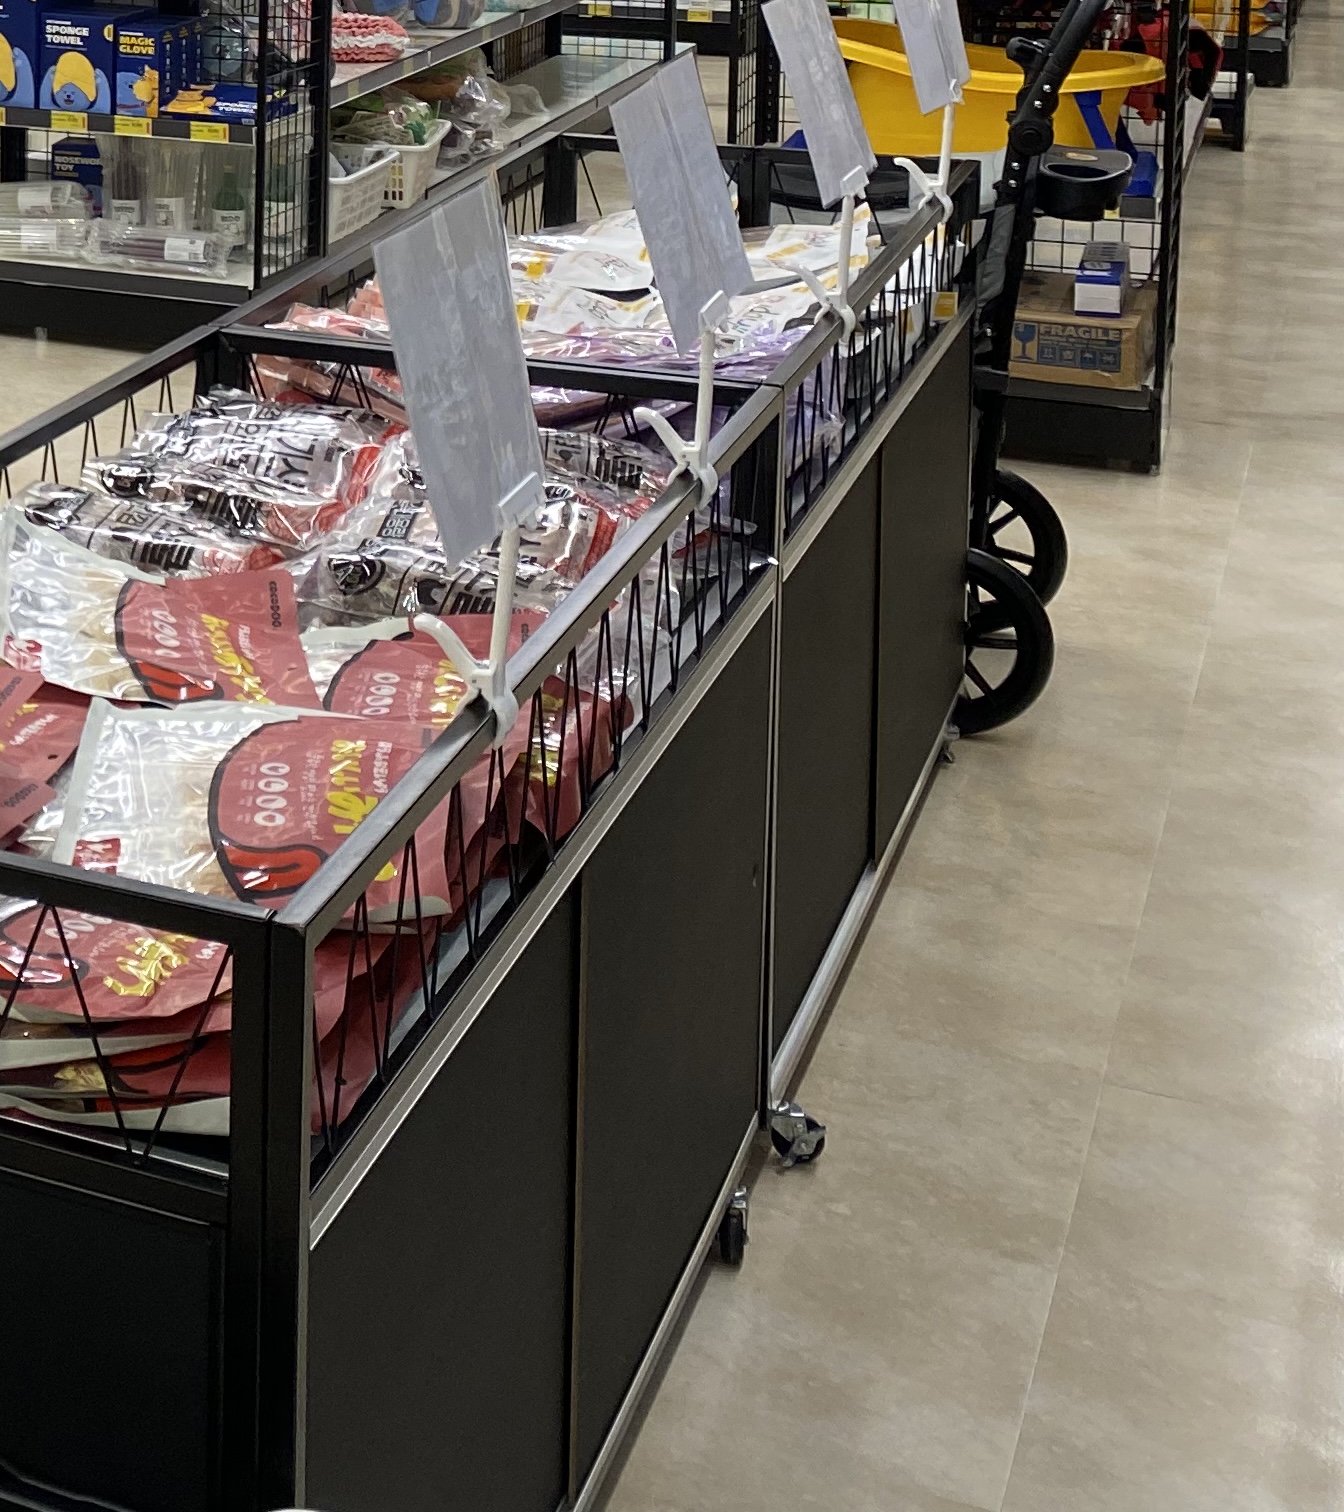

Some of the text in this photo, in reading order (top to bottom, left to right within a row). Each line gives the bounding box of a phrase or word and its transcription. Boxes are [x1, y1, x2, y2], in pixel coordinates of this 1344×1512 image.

[44, 23, 90, 38] SPONGE
[44, 33, 84, 46] TOWEL
[118, 35, 156, 47] MAGIC
[119, 43, 156, 56] GLOVE
[54, 164, 76, 172] TOY
